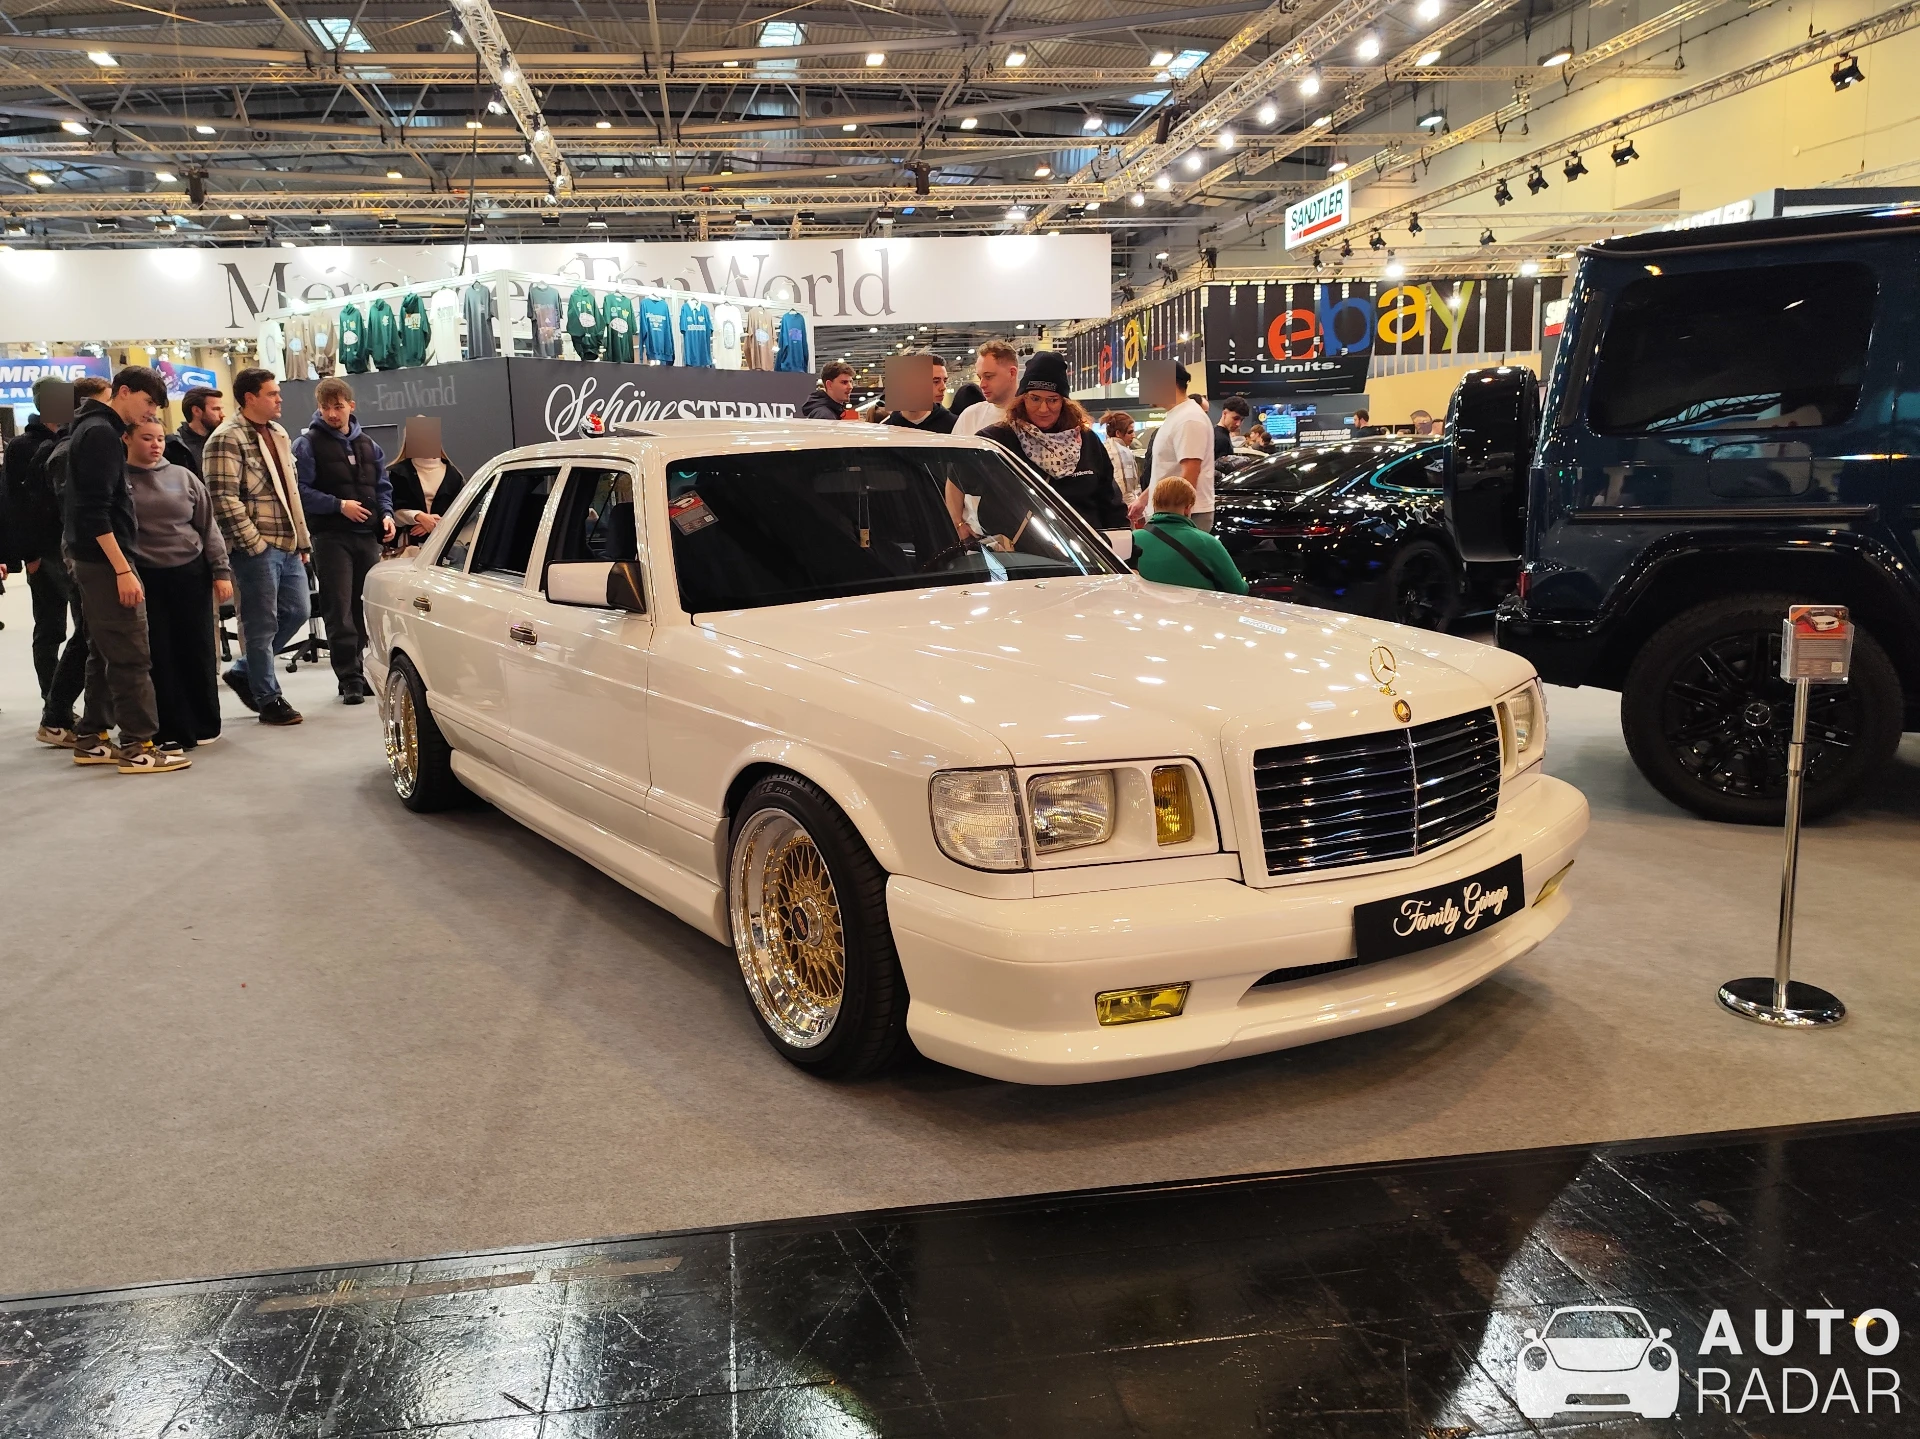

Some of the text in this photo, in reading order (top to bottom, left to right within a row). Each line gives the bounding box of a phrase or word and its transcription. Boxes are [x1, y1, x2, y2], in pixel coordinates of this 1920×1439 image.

[1291, 188, 1343, 231] SANDTLER
[1268, 281, 1475, 360] ebay
[1219, 361, 1342, 374] No Limits.
[1393, 882, 1509, 936] Family Garage
